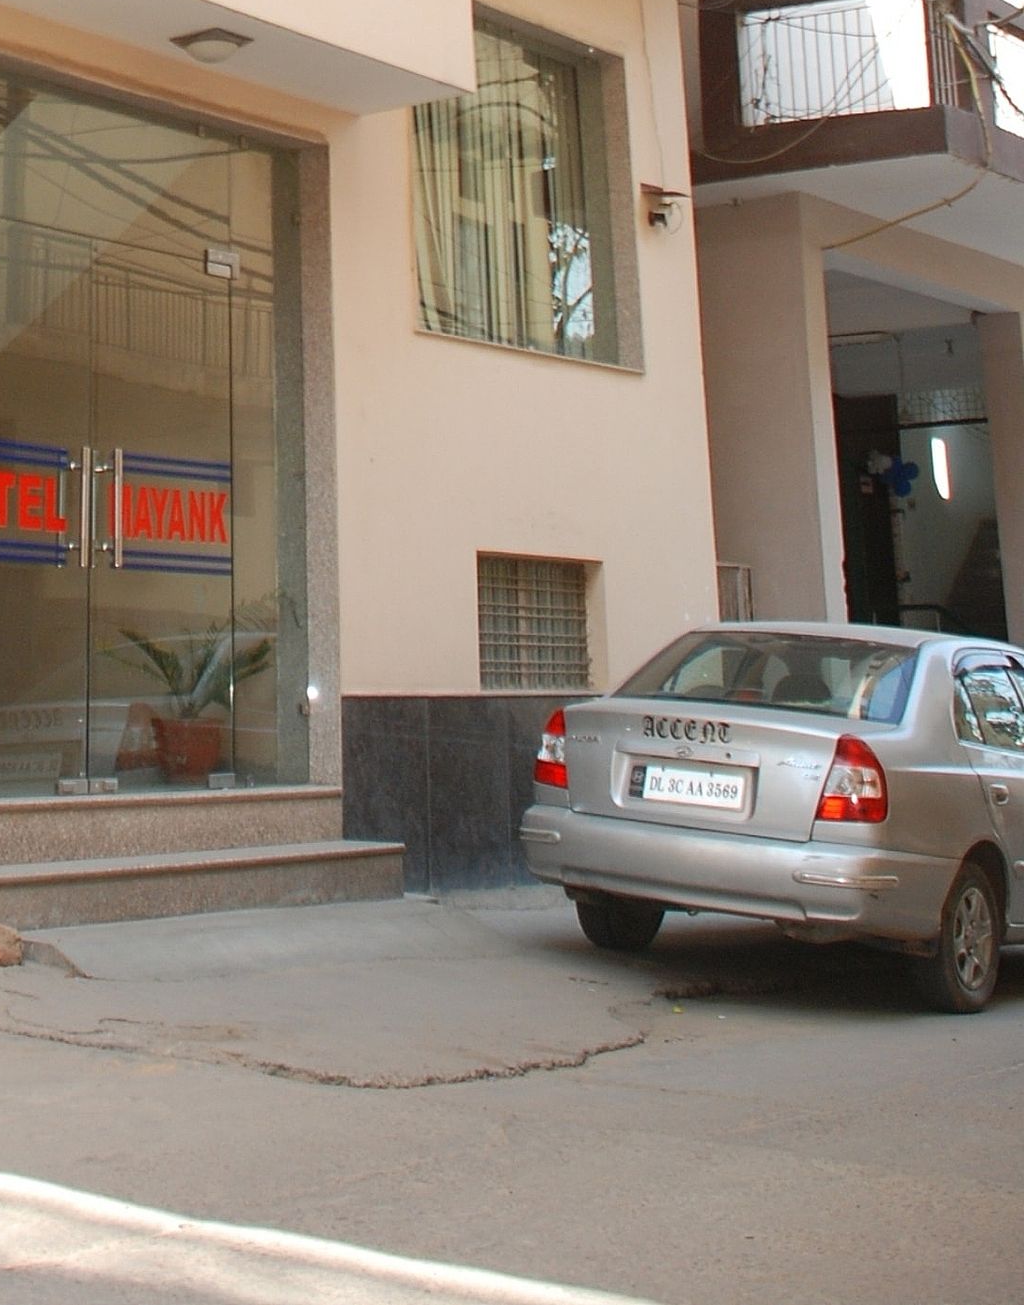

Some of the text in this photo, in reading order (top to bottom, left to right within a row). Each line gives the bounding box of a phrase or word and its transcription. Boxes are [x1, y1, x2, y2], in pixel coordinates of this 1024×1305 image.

[643, 715, 732, 744] ACCENT
[649, 775, 739, 799] DL 3C AA 3569
